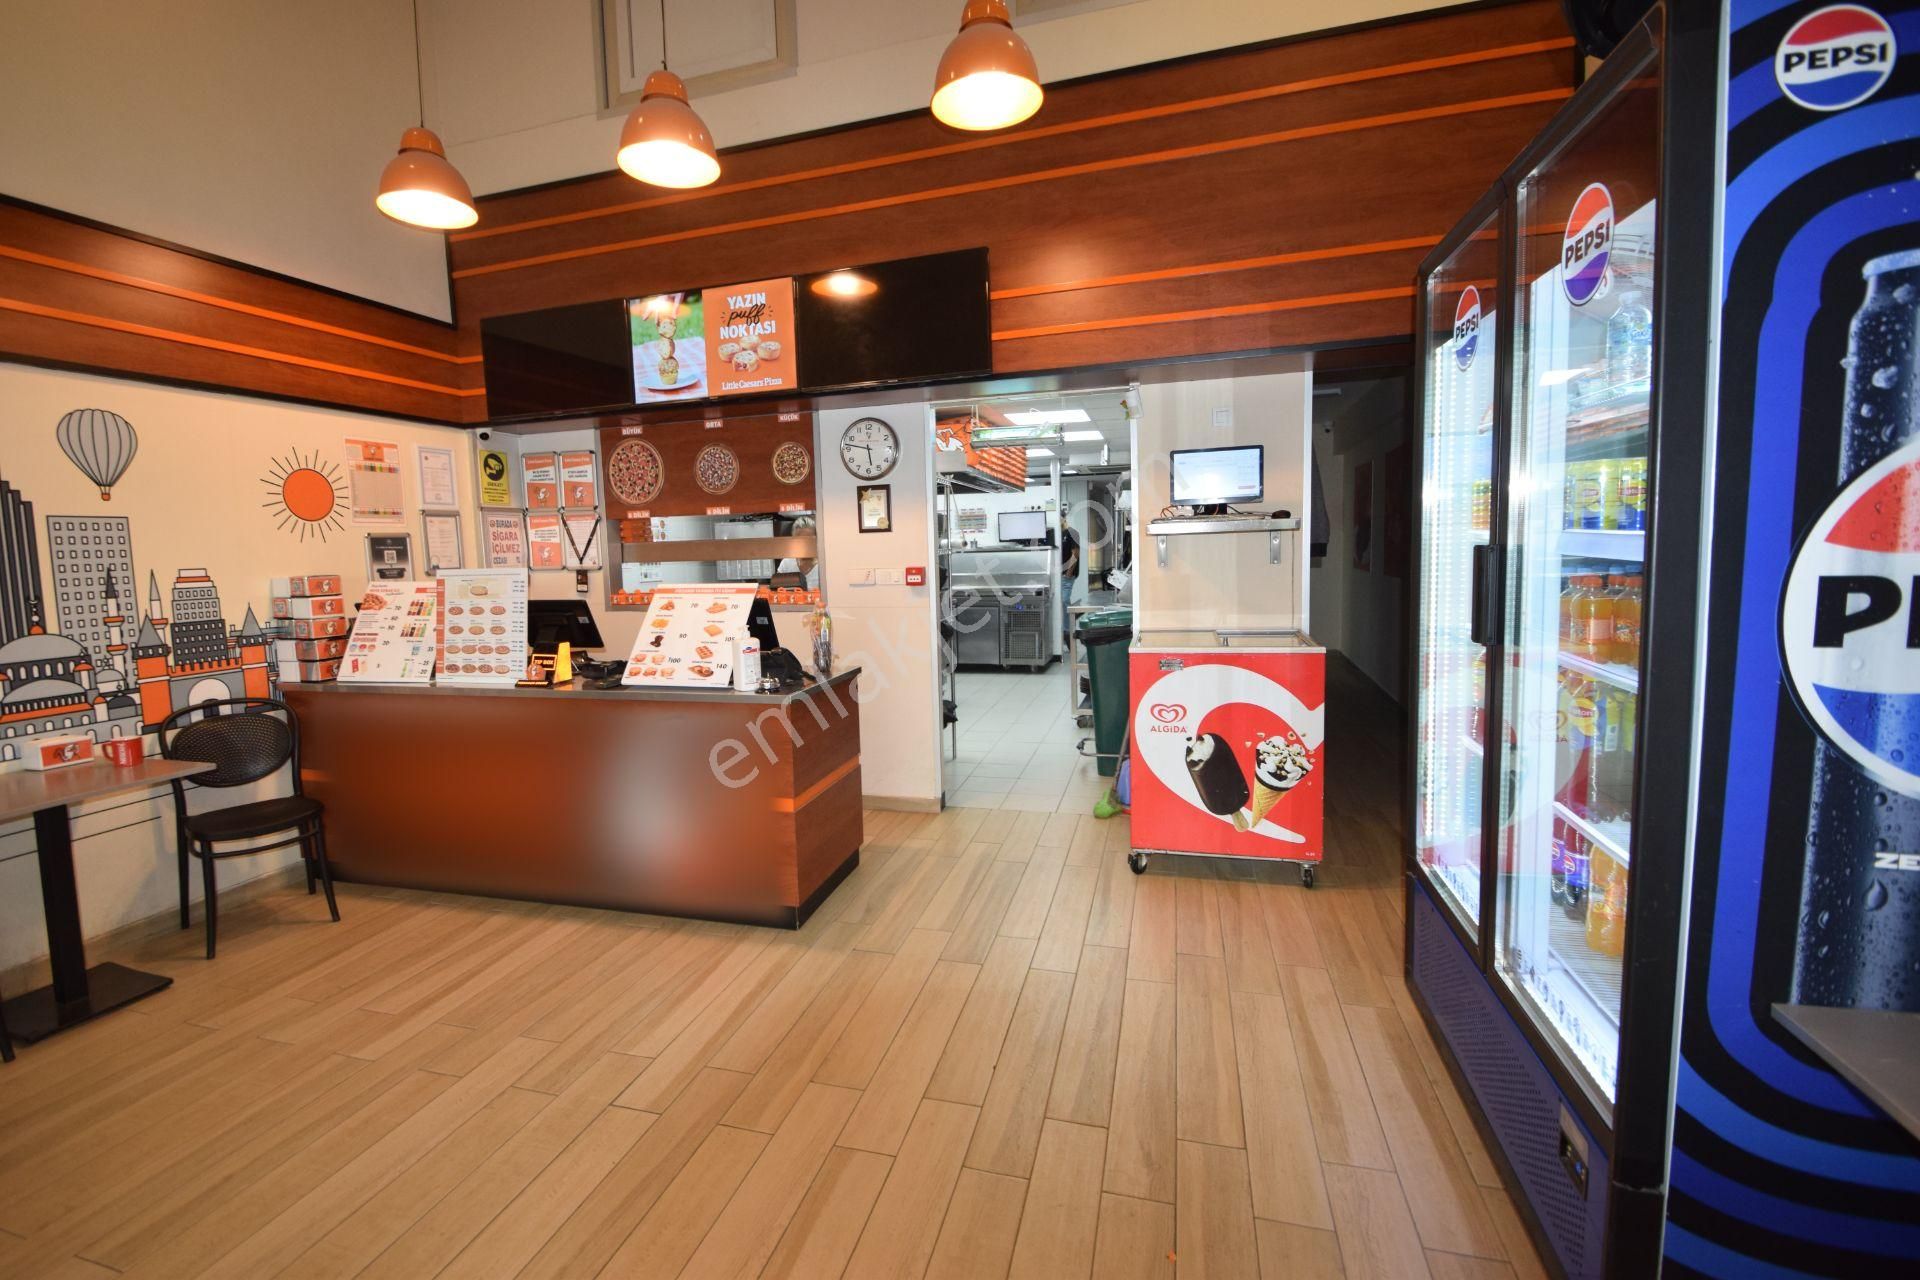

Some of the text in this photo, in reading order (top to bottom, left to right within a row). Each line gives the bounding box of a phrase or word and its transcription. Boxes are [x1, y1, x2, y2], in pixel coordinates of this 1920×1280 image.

[1783, 42, 1889, 73] PEPSI
[1564, 218, 1610, 270] PEPSI
[727, 292, 766, 310] YAZIN
[727, 303, 766, 326] puff
[719, 320, 776, 340] NOKTASI
[1455, 314, 1479, 343] PEPSI
[721, 377, 782, 391] Little Caesars Pizza
[705, 420, 721, 428] ORTA
[780, 413, 799, 421] KÜÇÜK
[622, 427, 642, 435] BÜYÜK
[712, 506, 730, 514] DİLİM
[786, 503, 804, 511] DİLİM
[492, 529, 519, 541] SİGARA
[492, 542, 521, 556] İÇİLMEZ
